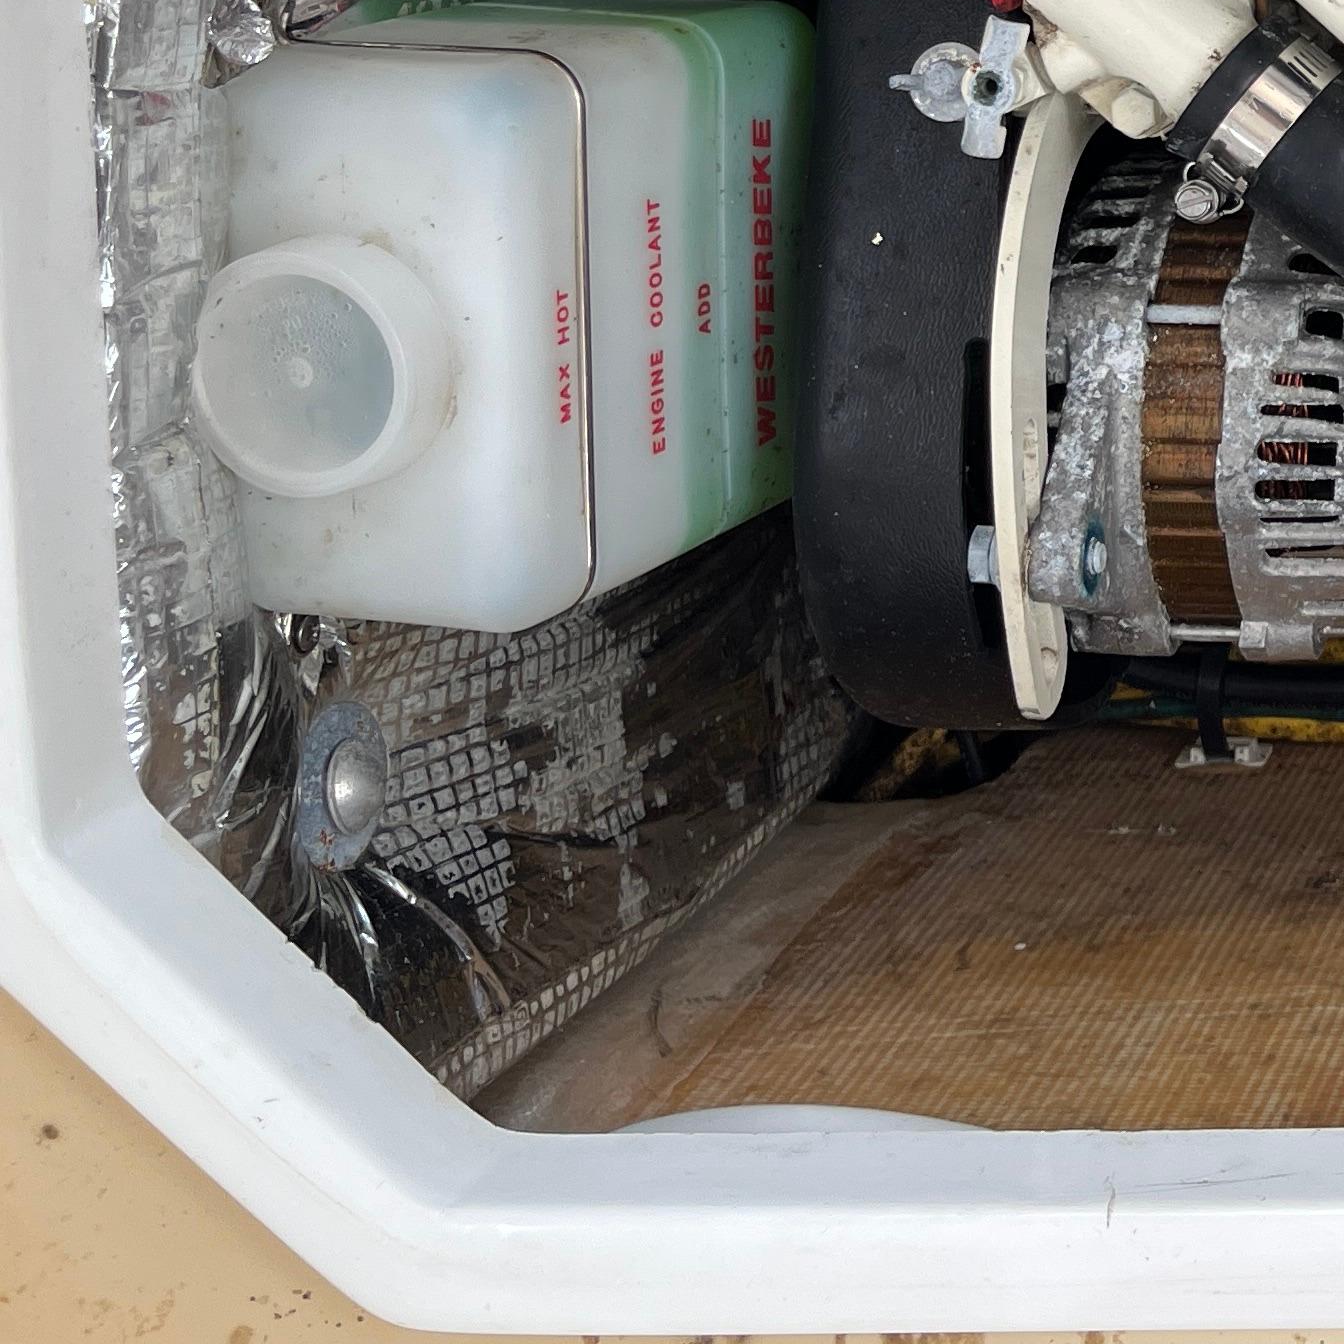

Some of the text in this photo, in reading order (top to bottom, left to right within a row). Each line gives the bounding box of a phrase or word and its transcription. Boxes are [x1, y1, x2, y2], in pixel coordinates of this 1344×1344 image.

[555, 289, 572, 424] MAX HOT
[645, 198, 666, 455] ENGINE COOLANT
[696, 282, 712, 334] ADD
[751, 118, 777, 447] WESTERBEKE
